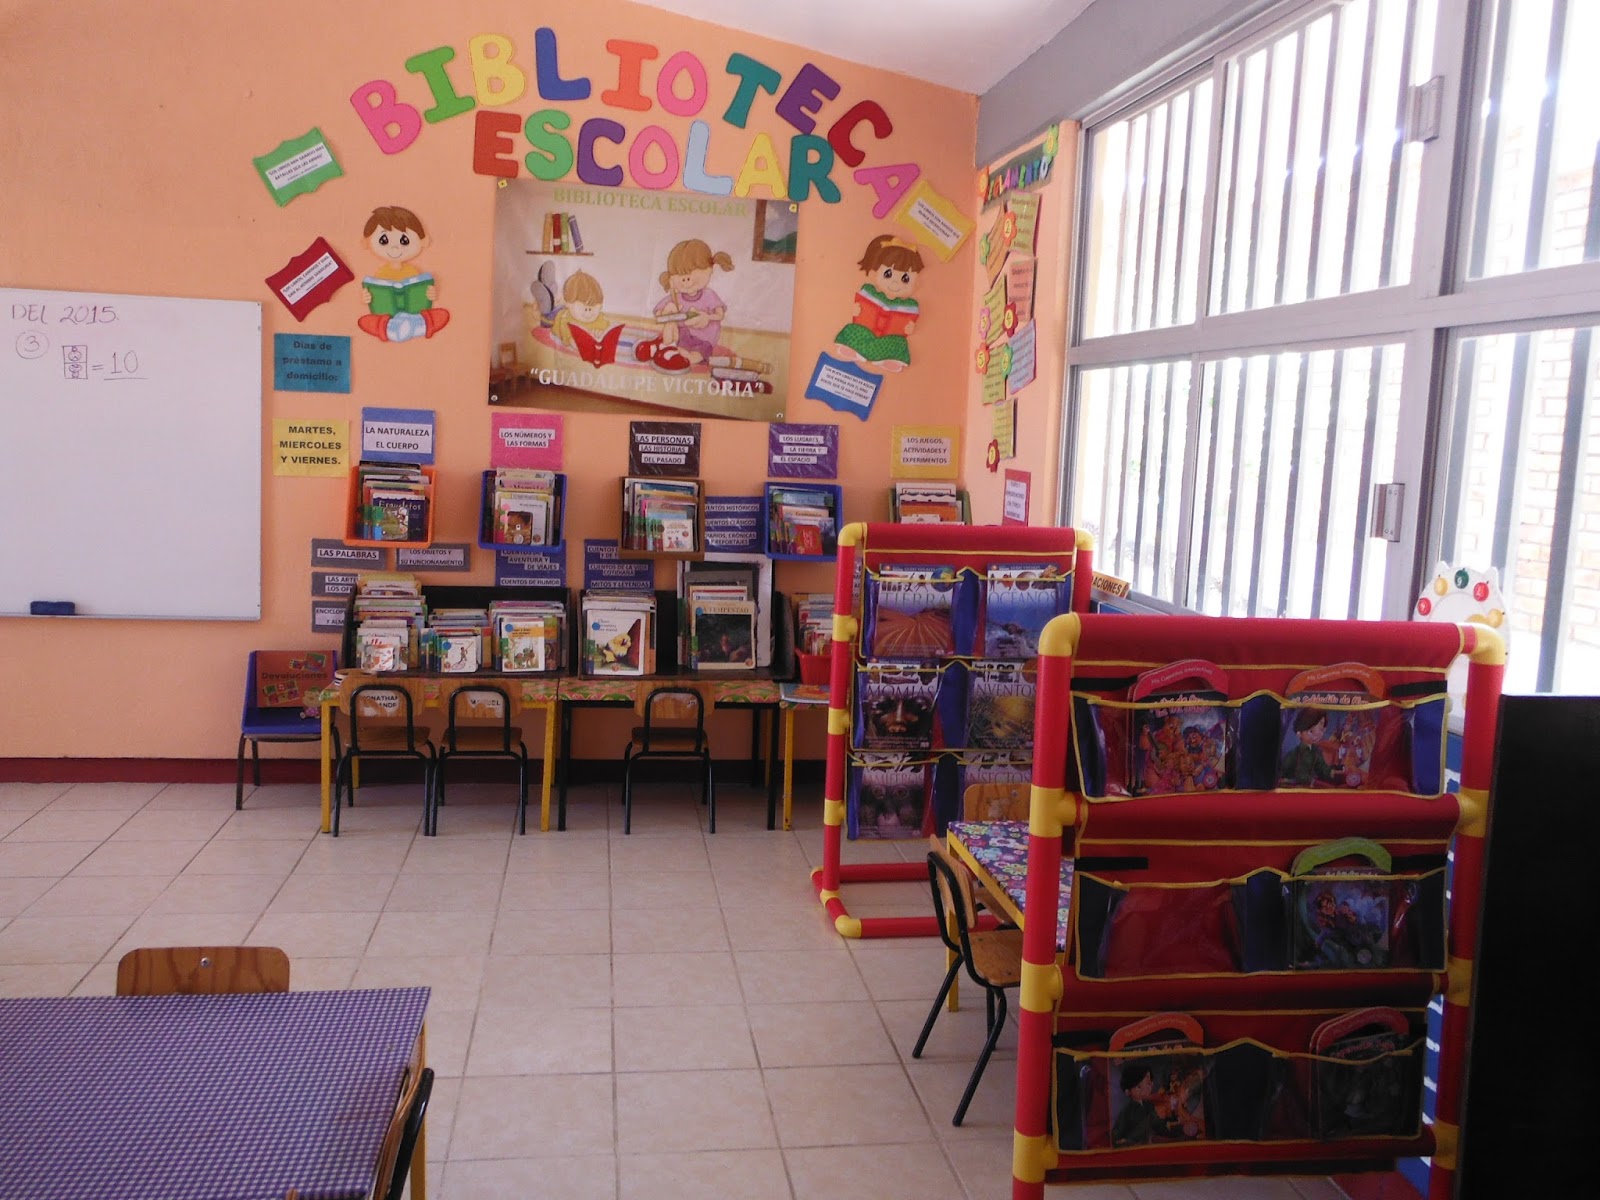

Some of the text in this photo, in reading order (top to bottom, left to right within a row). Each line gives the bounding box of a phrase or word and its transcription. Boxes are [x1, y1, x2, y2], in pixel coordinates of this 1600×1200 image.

[350, 27, 921, 220] BIBLIOTECA
[473, 109, 841, 204] ESCOLAR
[553, 187, 748, 217] BIBLIOTECA ESCOLAR
[12, 303, 48, 325] DEL
[319, 341, 332, 351] de
[111, 350, 139, 375] 10
[288, 426, 336, 436] MARTES,
[365, 427, 430, 437] LA NATURALEZA
[279, 440, 342, 450] MIERCOLES
[519, 440, 547, 448] FORMAS
[636, 435, 692, 445] LAS PERSONAS
[375, 441, 419, 450] EL CUERPO
[281, 456, 341, 465] Y VIERNES.
[336, 550, 377, 558] PALABRAS
[1093, 576, 1123, 595] ACIONES
[881, 592, 949, 607] TIERRA
[262, 672, 328, 680] Devoluciones
[867, 684, 935, 699] MOMIAS
[976, 683, 1037, 697] NVENTOS
